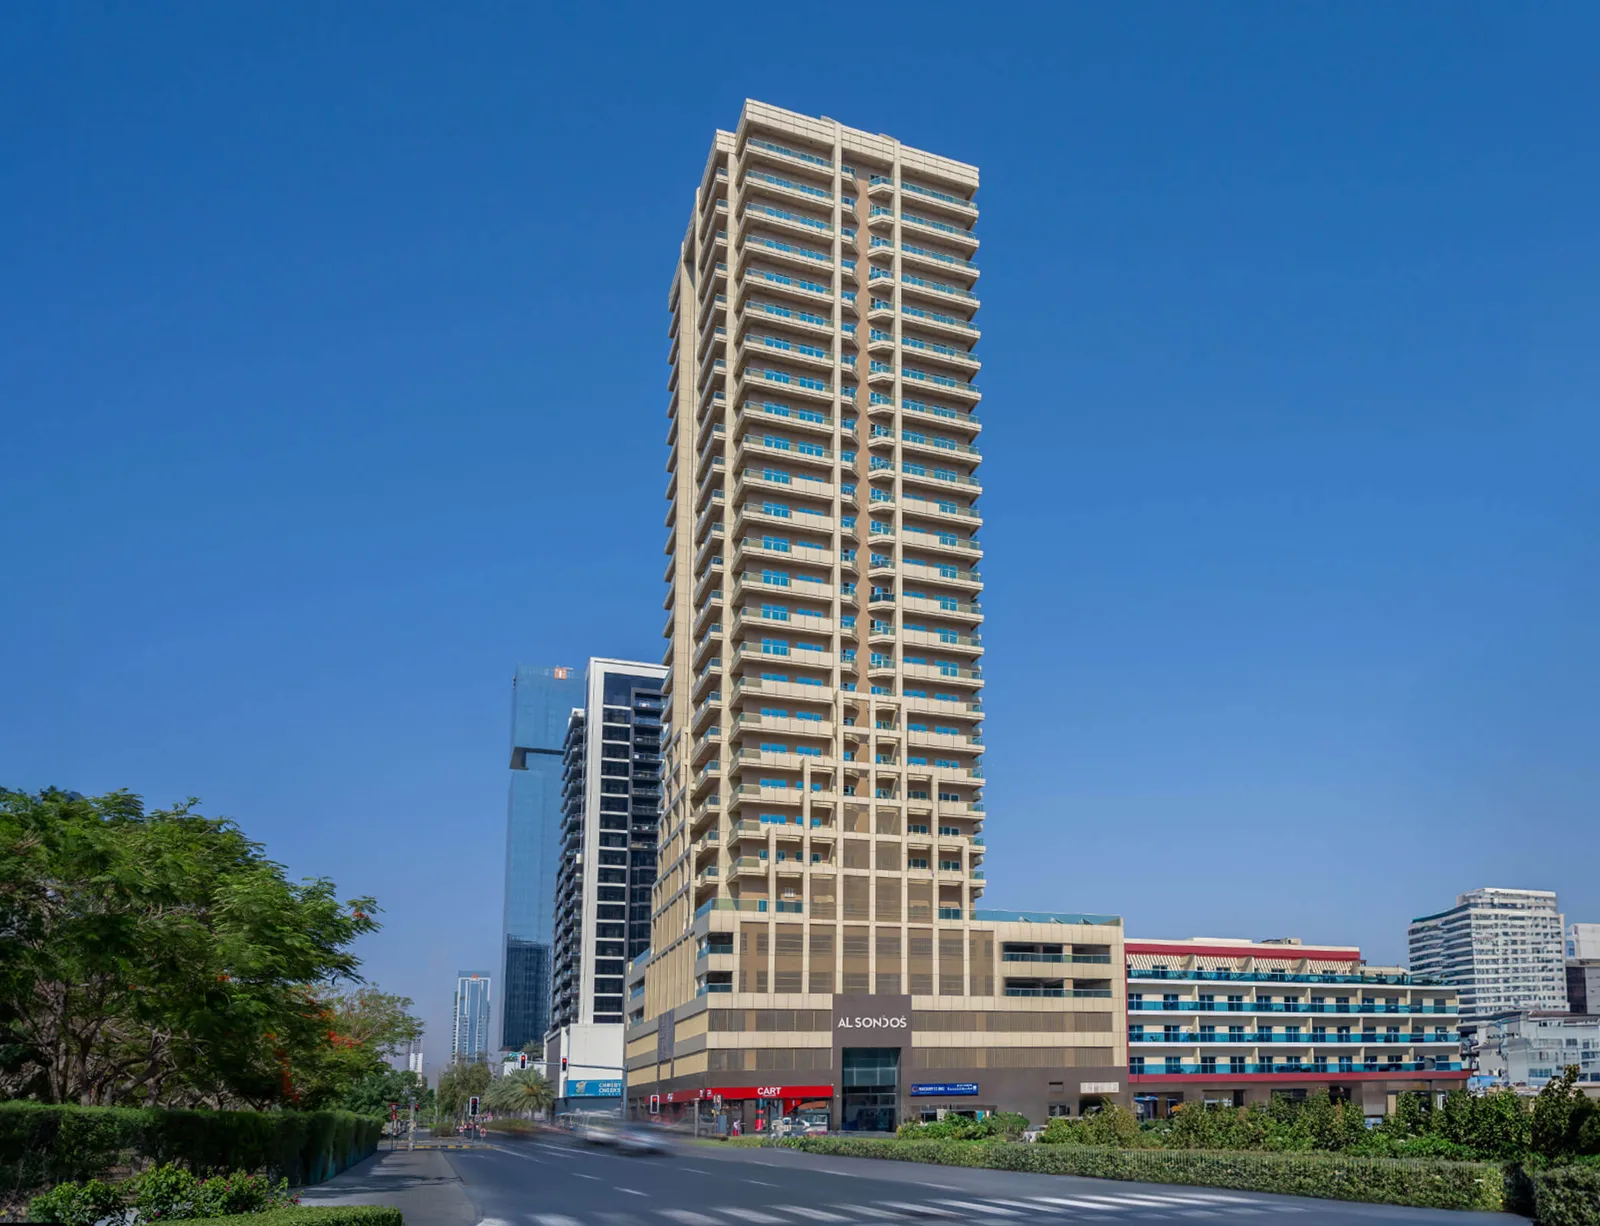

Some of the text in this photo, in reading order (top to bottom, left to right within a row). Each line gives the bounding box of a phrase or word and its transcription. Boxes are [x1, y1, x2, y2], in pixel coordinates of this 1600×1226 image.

[837, 1016, 907, 1028] AL SONDOS
[757, 1086, 782, 1096] CART
